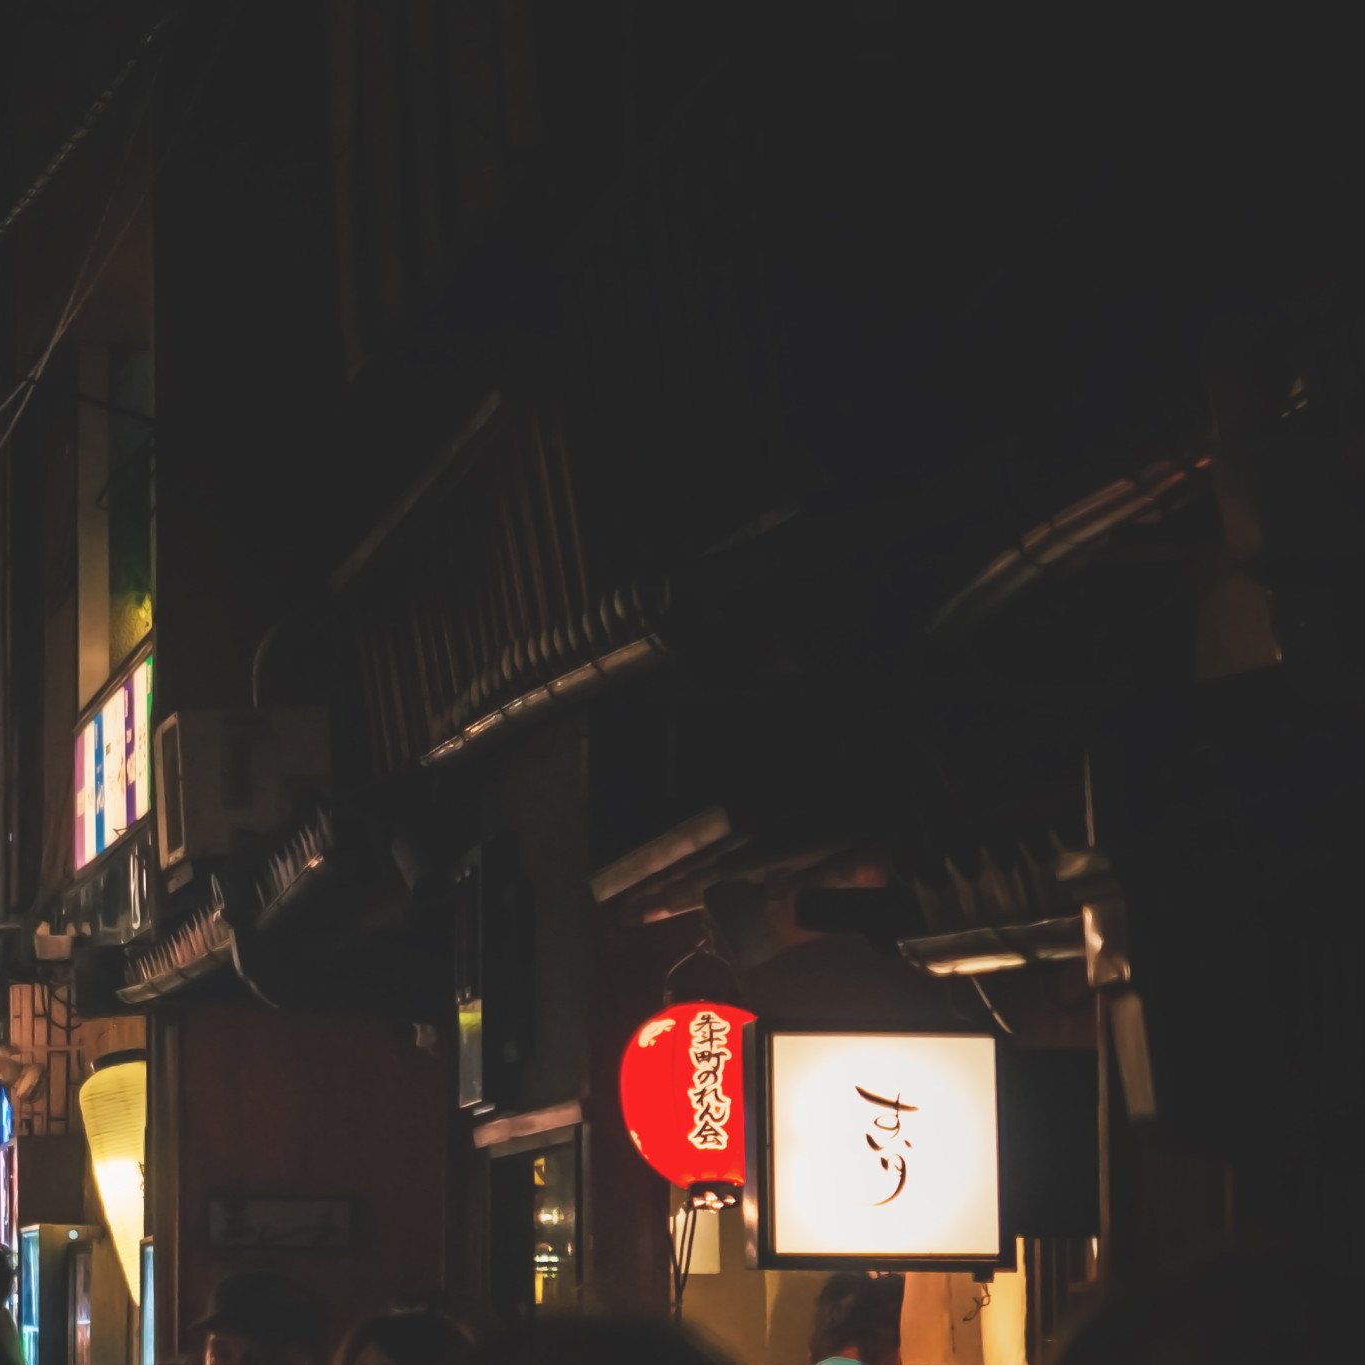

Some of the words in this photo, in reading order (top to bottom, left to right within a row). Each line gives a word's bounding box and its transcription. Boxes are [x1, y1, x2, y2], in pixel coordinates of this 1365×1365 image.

[690, 1011, 731, 1149] 先斗町のれん会
